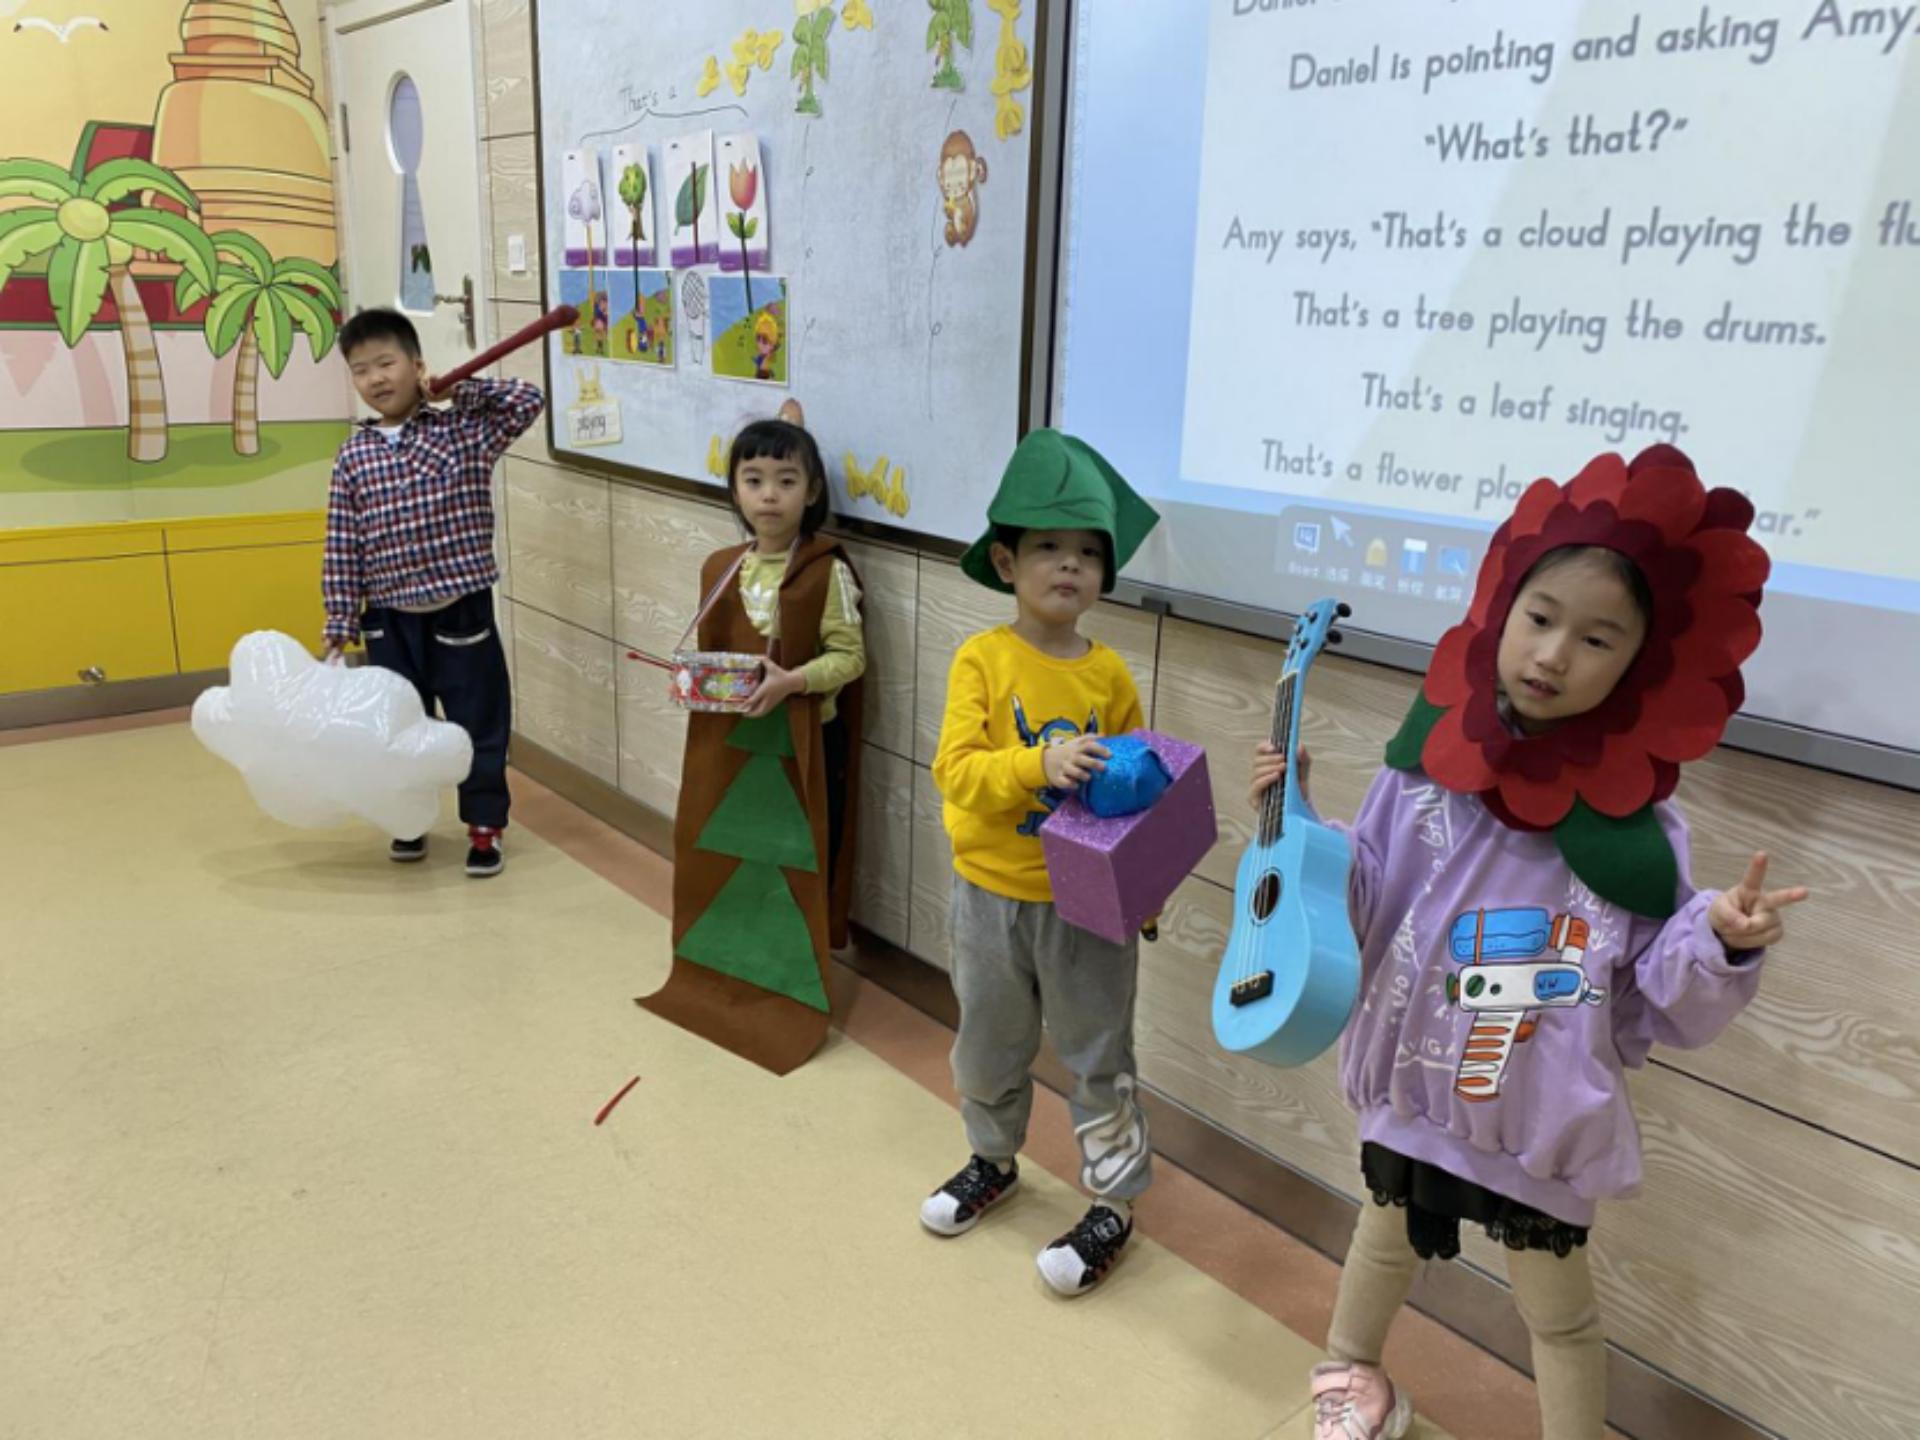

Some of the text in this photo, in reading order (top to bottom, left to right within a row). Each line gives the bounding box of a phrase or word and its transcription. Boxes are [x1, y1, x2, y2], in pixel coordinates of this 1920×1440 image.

[1289, 0, 1920, 93] Daniel is pointing and asking Amy
[1221, 214, 1285, 265] Amy
[1295, 228, 1358, 265] says,
[1481, 226, 1503, 249] a
[1517, 205, 1611, 249] cloud
[1620, 205, 1763, 267] playing
[1782, 201, 1853, 248] the
[1879, 200, 1920, 249] flu
[1292, 289, 1827, 355] That's a tree playing the drums.
[1360, 371, 1690, 447] That's a leaf singing.
[1261, 438, 1334, 478] That's
[1345, 461, 1363, 482] a
[1376, 450, 1464, 494] flower
